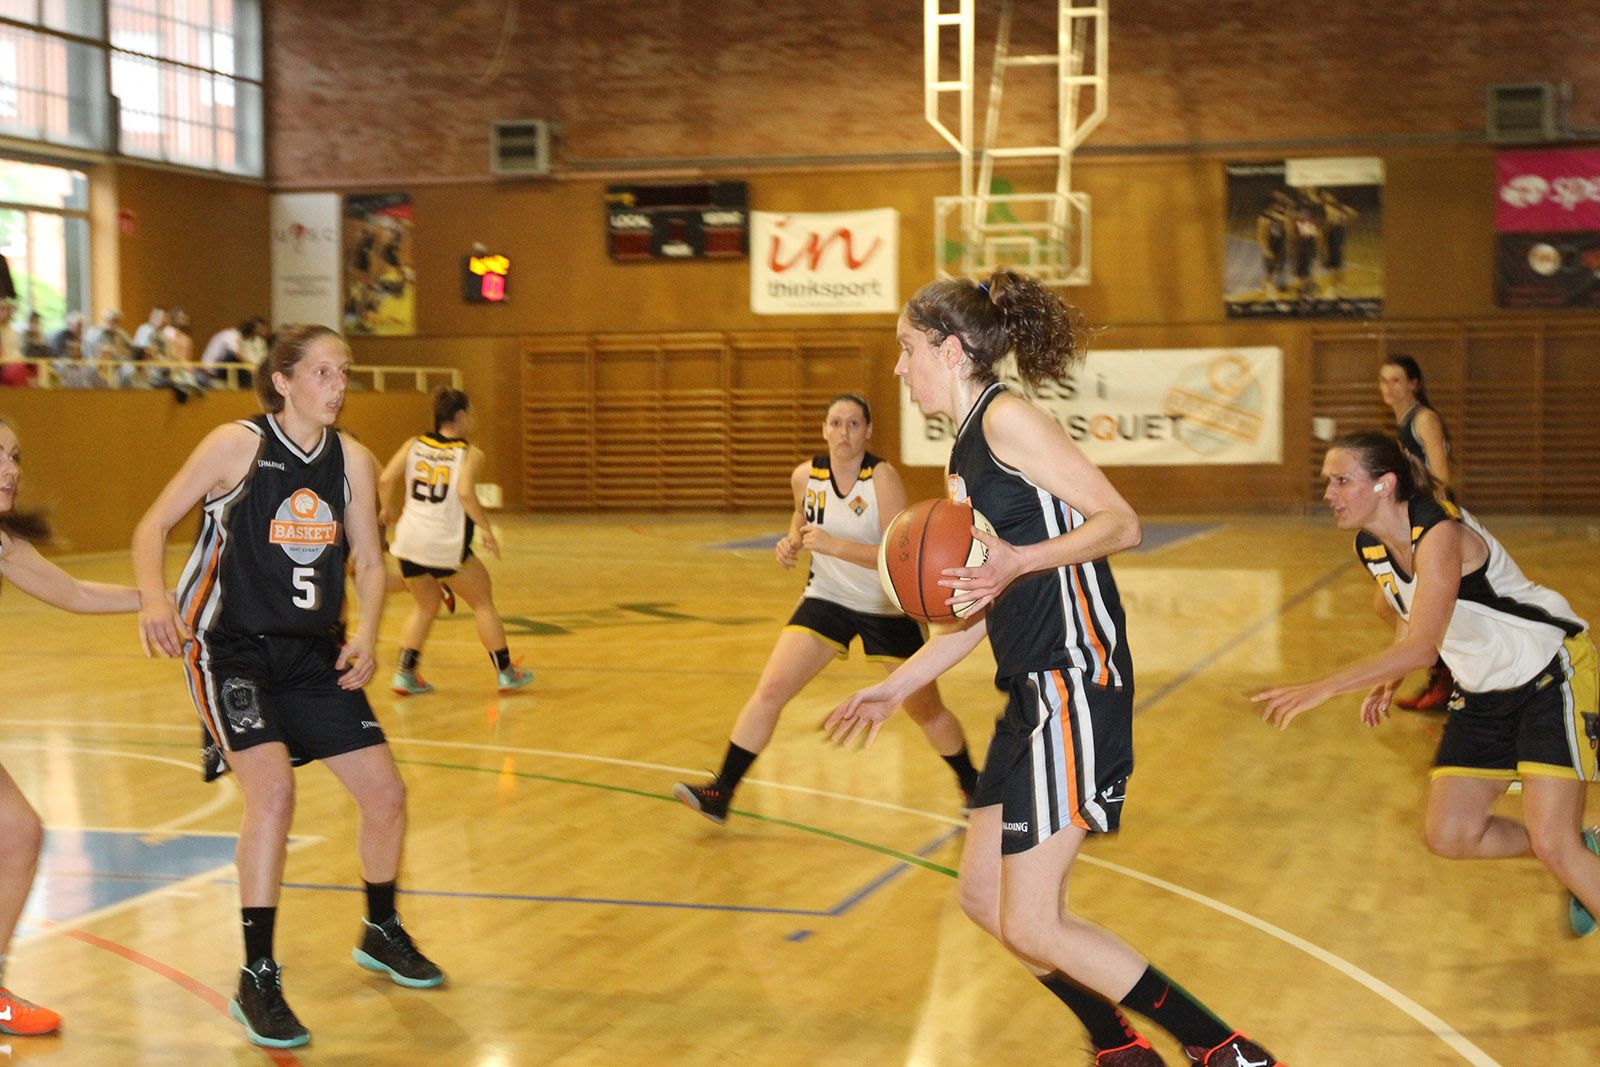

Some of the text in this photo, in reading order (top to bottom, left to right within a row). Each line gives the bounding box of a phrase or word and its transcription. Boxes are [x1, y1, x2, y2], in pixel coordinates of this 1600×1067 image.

[767, 215, 884, 273] in
[768, 278, 882, 299] thinksport
[412, 461, 450, 503] 20
[805, 489, 826, 525] 31
[274, 524, 332, 541] BASKET
[292, 567, 315, 609] 5
